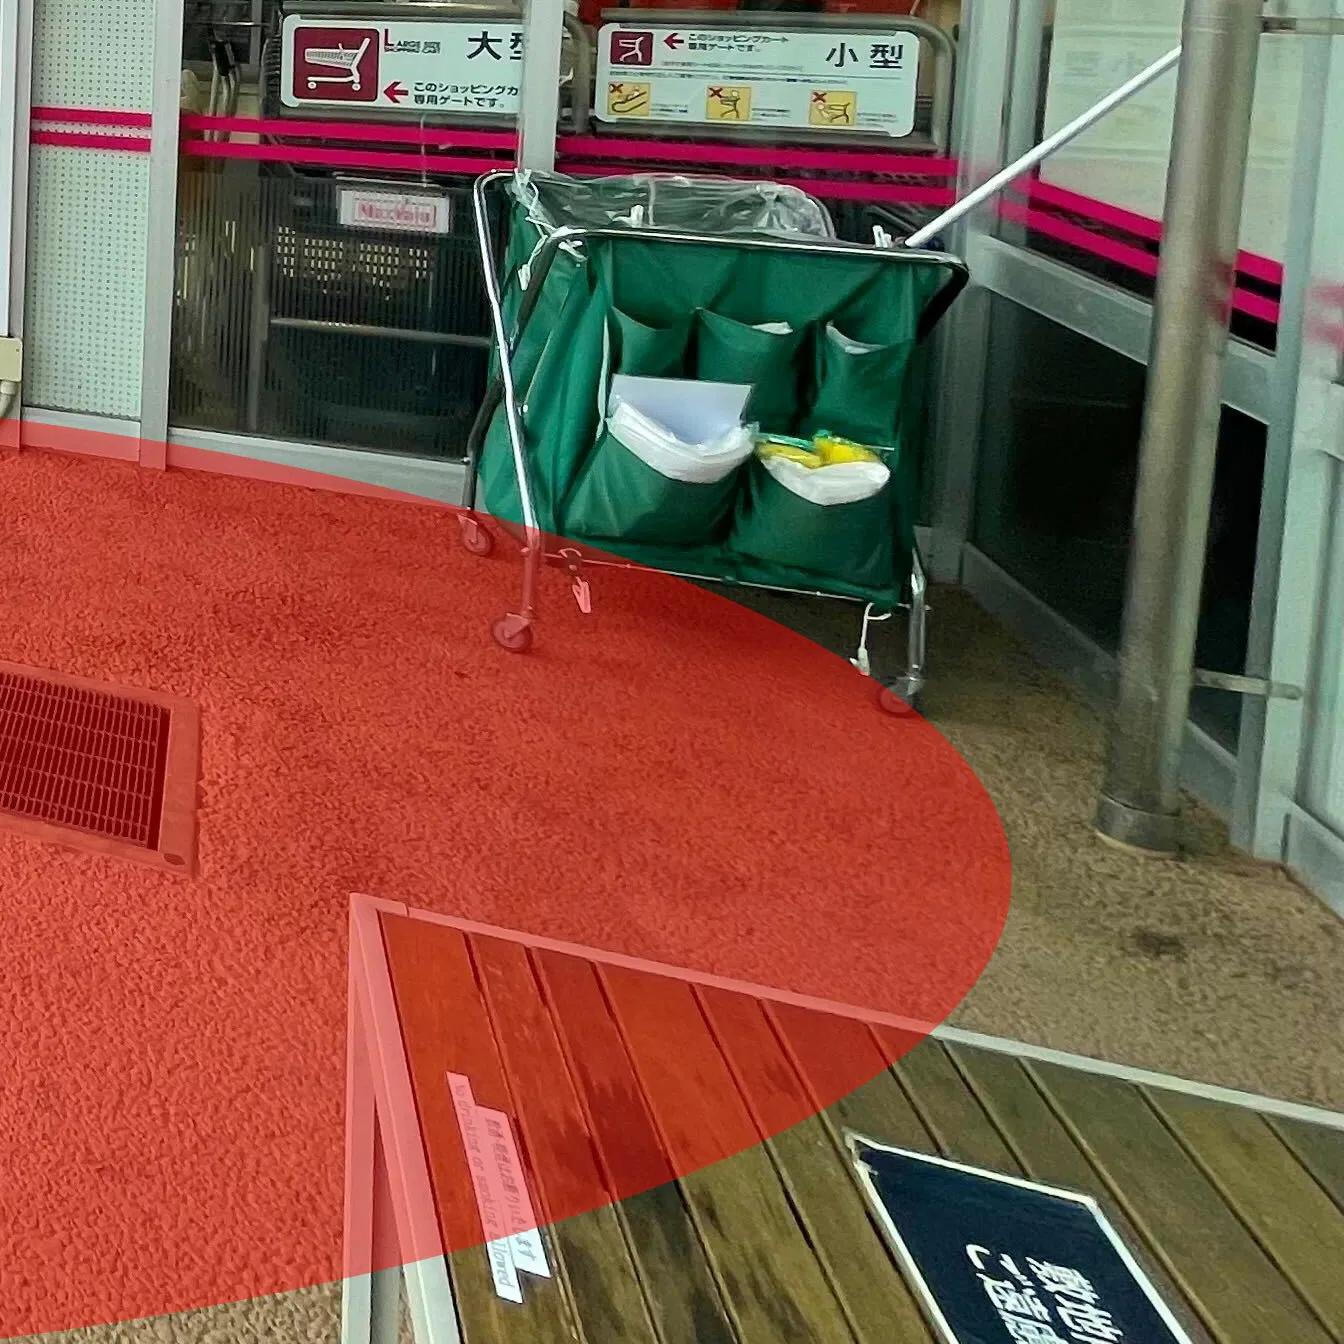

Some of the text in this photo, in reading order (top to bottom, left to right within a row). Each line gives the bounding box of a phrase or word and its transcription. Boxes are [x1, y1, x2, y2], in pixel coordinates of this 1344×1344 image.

[688, 33, 789, 44] このショッピングカート
[825, 42, 904, 69] 小型
[414, 95, 505, 108] 専用ゲートです。
[488, 1230, 516, 1289] allowed
[1025, 1256, 1125, 1344] 敷地
